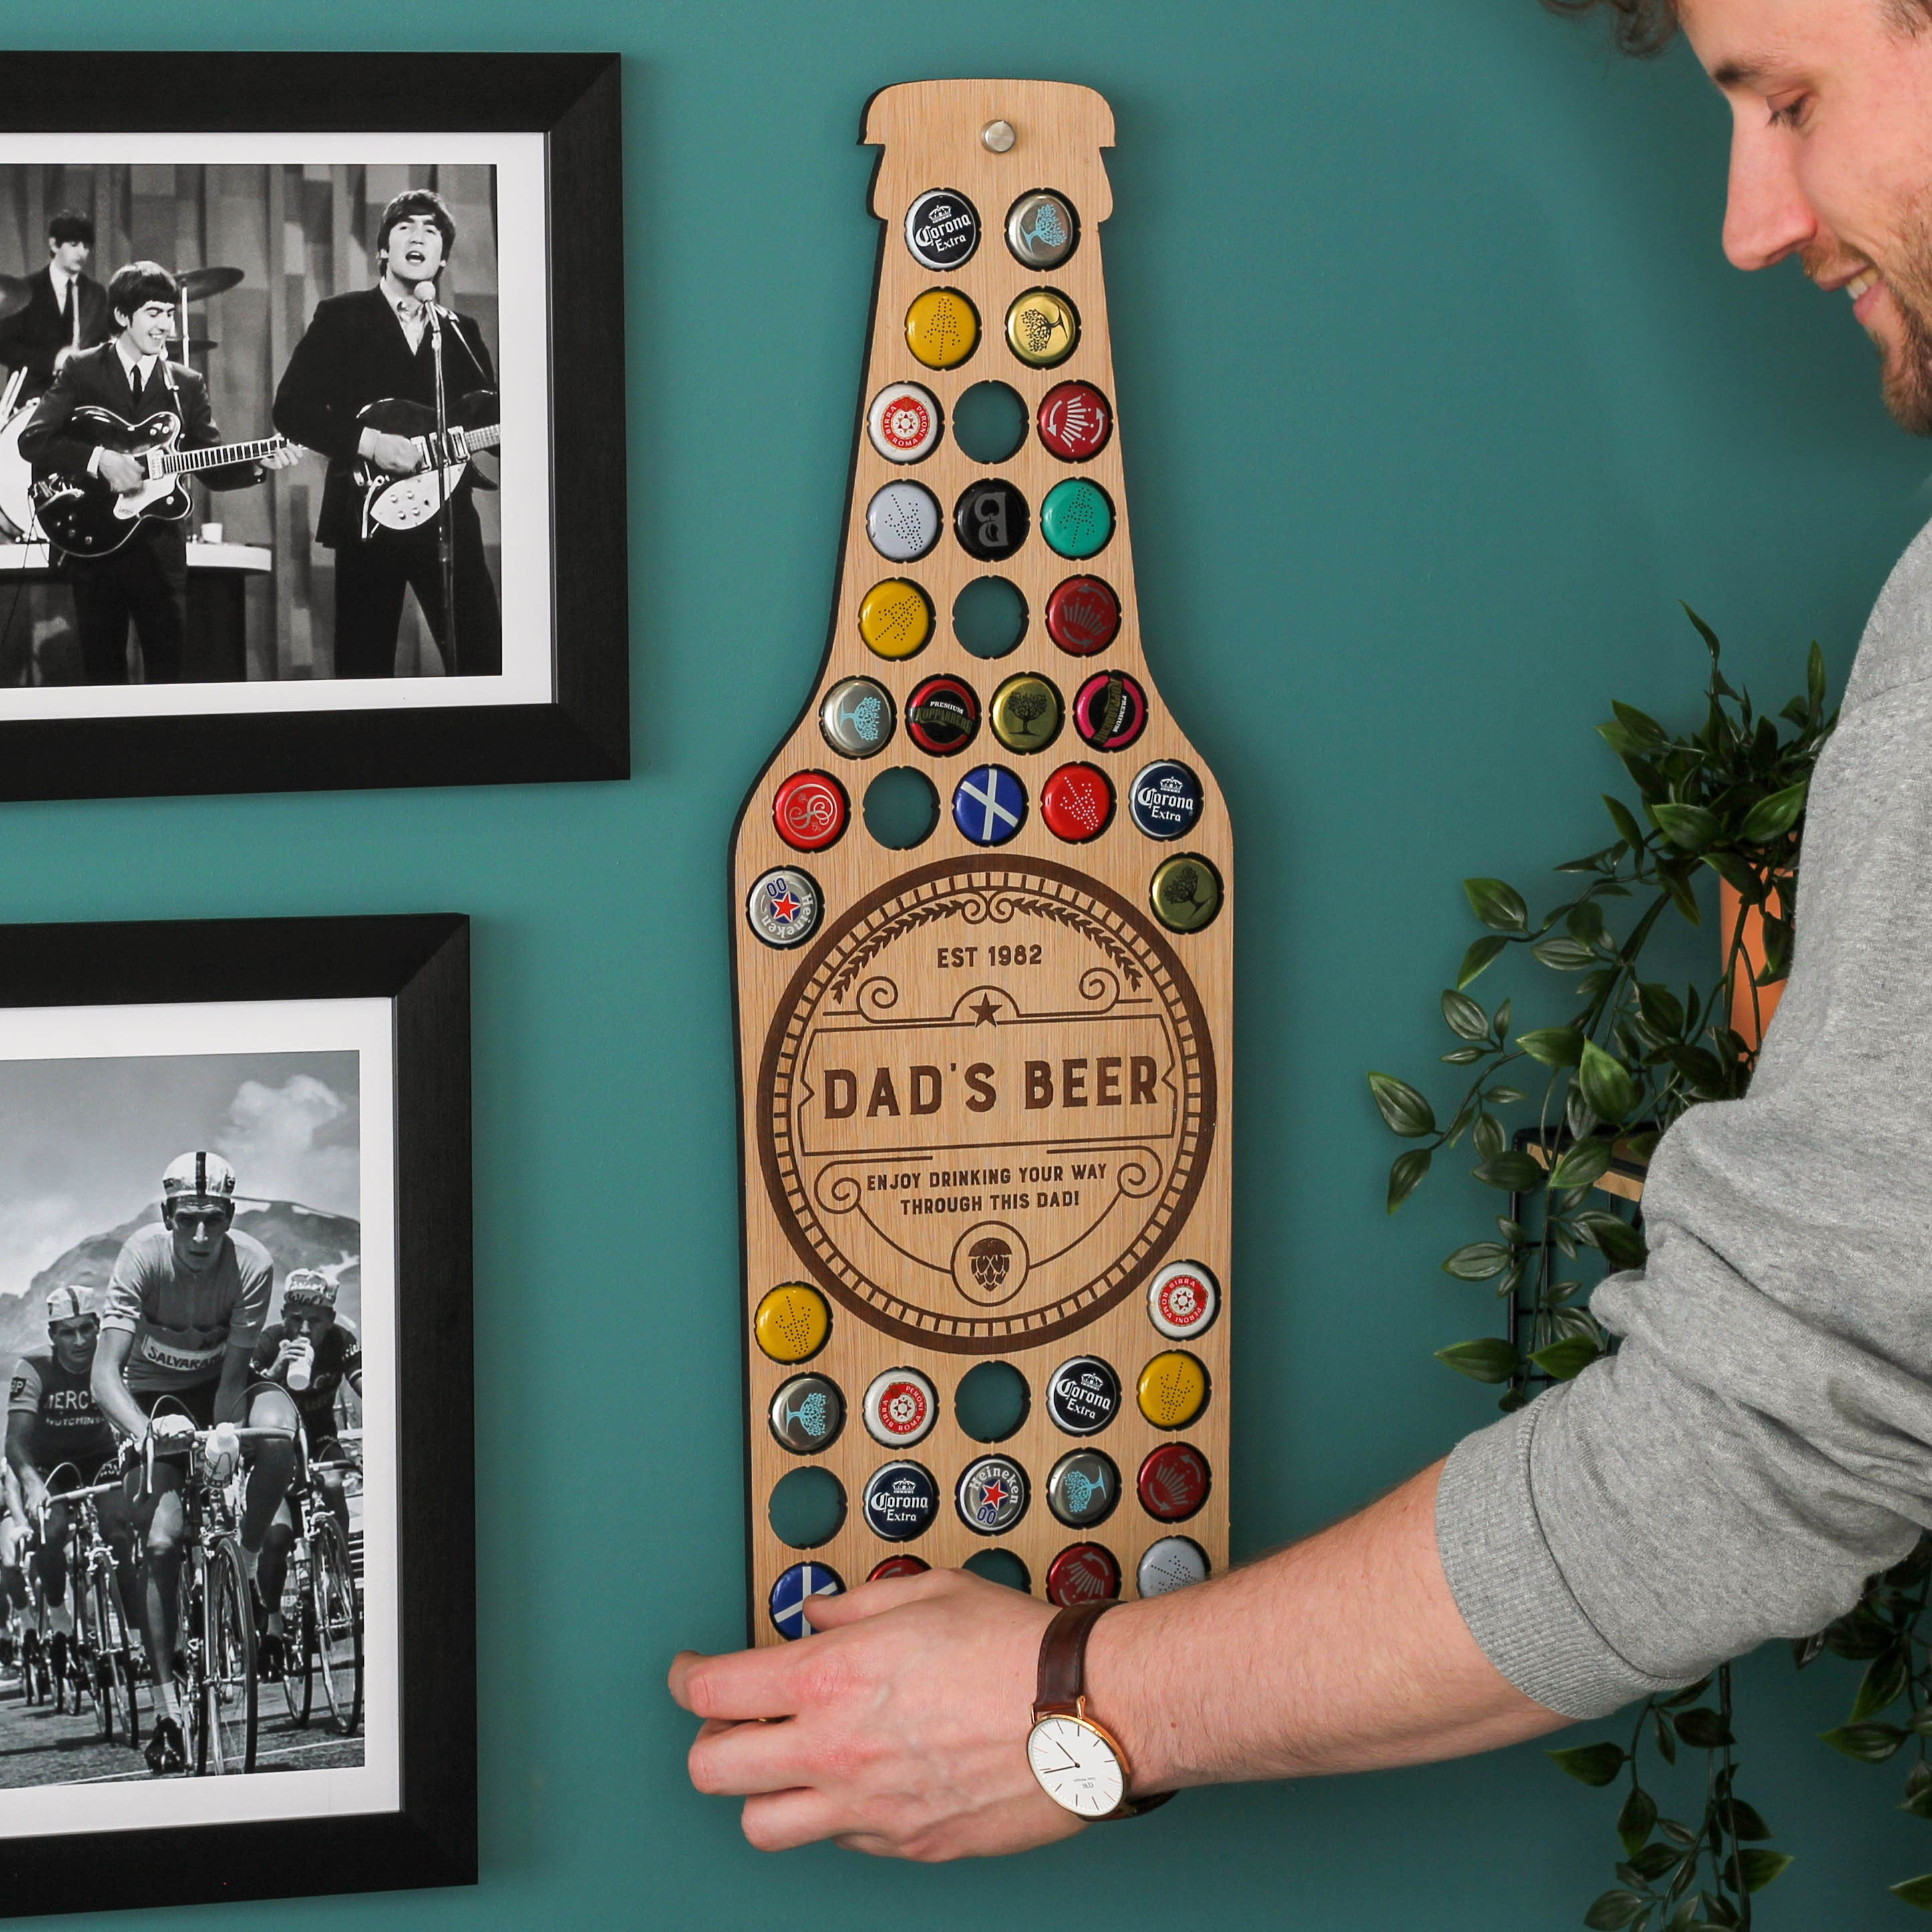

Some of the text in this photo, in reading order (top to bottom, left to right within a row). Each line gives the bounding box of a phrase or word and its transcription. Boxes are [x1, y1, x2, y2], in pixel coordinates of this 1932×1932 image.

[915, 214, 971, 247] Corona
[935, 234, 967, 253] Extra
[884, 406, 897, 434] BIRRA
[916, 406, 928, 436] PERONI
[893, 437, 918, 446] ROMA
[929, 701, 964, 714] PREMIUM
[1137, 787, 1193, 810] Corona
[1151, 805, 1181, 822] Extra
[762, 893, 814, 939] Heineken
[937, 944, 1042, 969] EST 1982
[823, 1055, 1158, 1120] DAD'S BEER
[866, 1163, 1107, 1191] ENJOY DRINKING YOUR WAY
[900, 1190, 1079, 1216] THROUGH THIS DAD!
[1169, 1278, 1195, 1289] BIRRA
[1161, 1292, 1172, 1319] ROMA
[1175, 1307, 1202, 1323] PERONI
[905, 1386, 924, 1411] PERONI
[1056, 1378, 1111, 1410] Corona
[882, 1400, 895, 1428] BIRRA
[1066, 1398, 1096, 1419] Extra
[898, 1416, 921, 1431] ROMA
[968, 1466, 1019, 1504] Heineken
[870, 1492, 928, 1513] Corona
[887, 1508, 917, 1522] Extra
